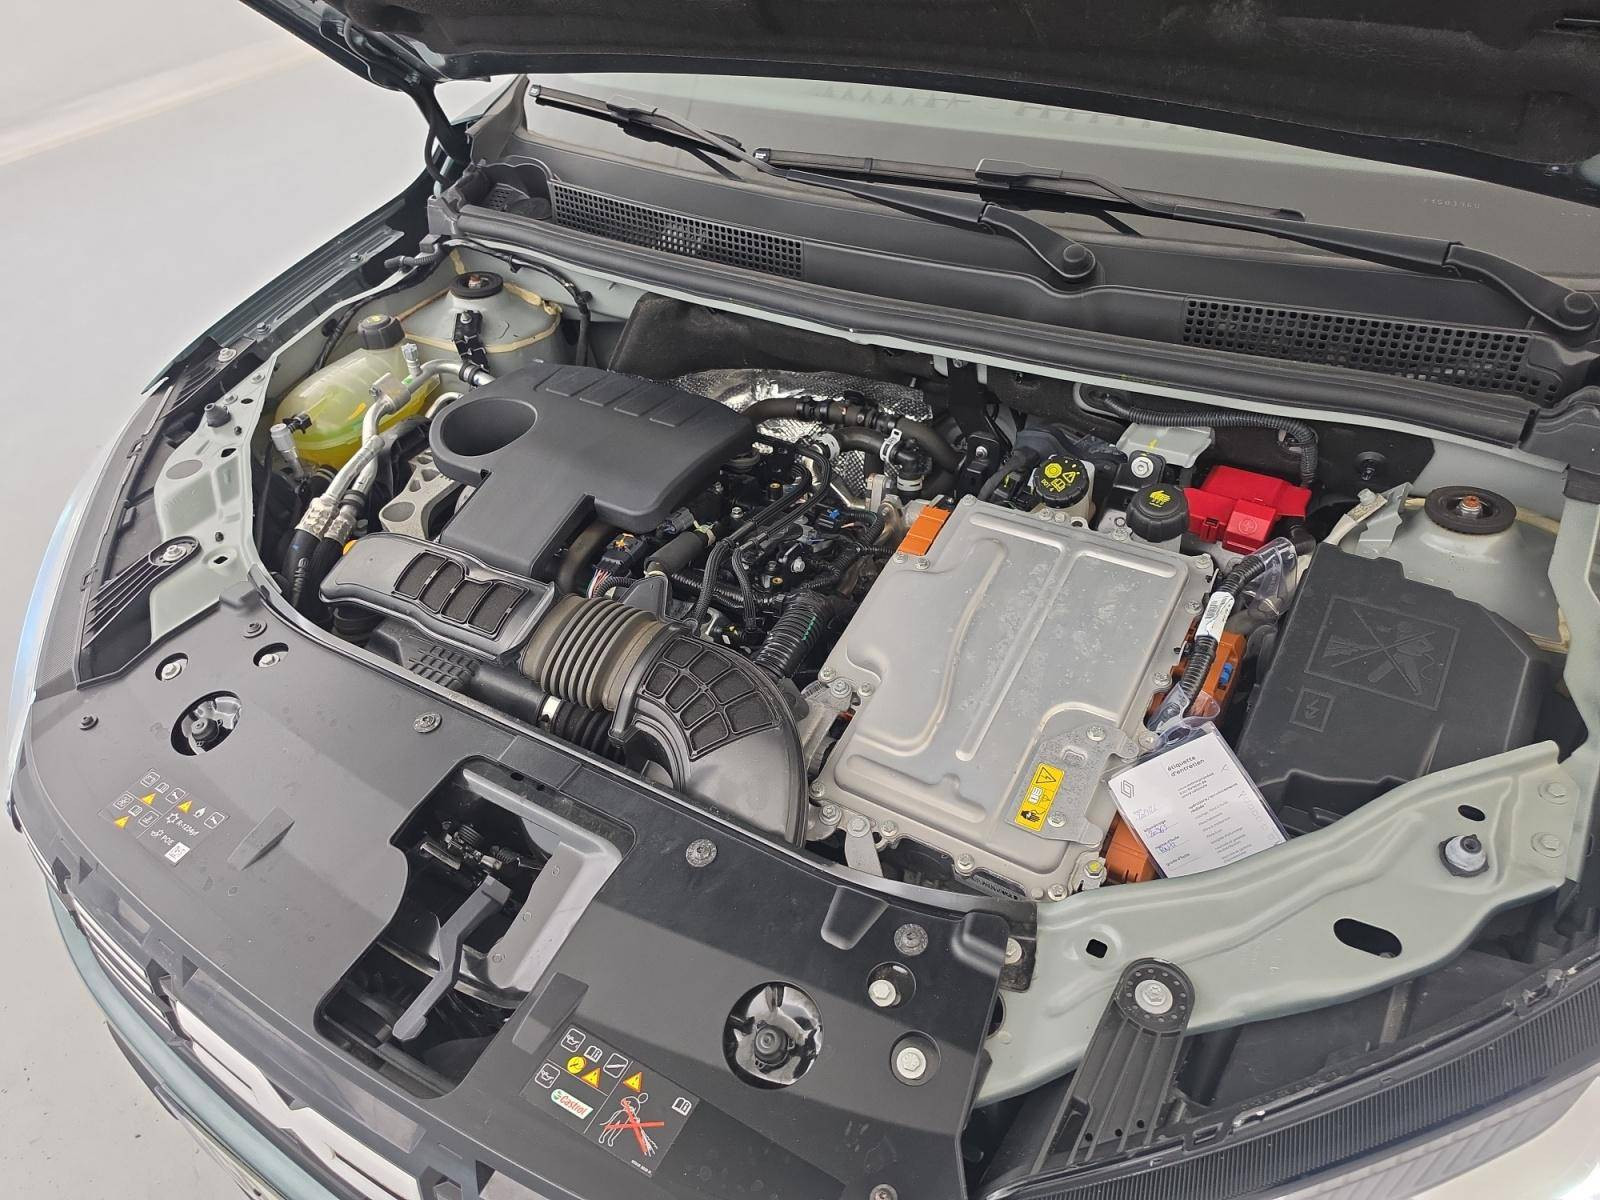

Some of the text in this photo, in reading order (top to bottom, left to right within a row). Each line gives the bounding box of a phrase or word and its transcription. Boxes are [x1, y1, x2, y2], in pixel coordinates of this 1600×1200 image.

[1041, 479, 1051, 488] DOT
[1171, 759, 1205, 777] d'entretien
[160, 834, 175, 846] POE
[559, 1094, 589, 1116] Castrol
